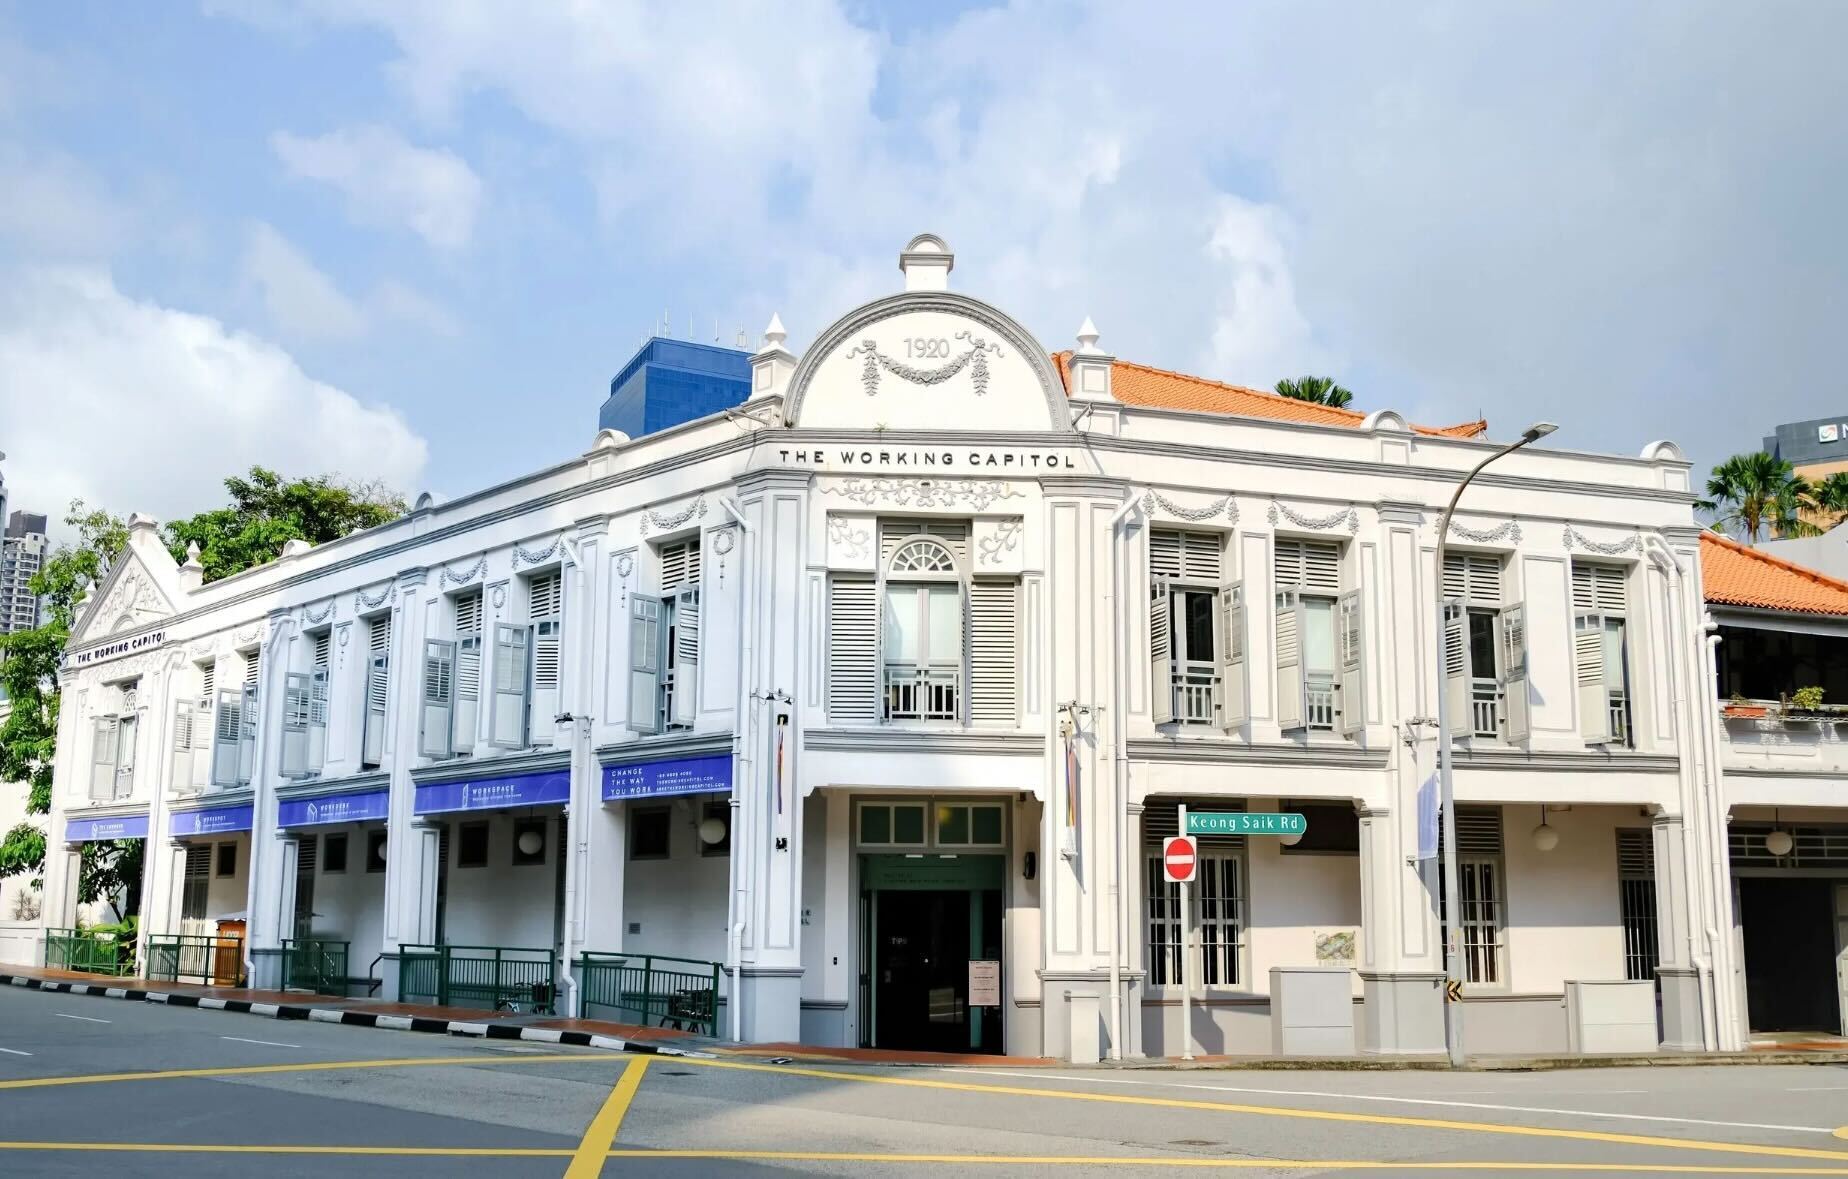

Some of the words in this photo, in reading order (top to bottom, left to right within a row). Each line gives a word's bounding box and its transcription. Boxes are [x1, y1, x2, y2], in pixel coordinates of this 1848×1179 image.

[903, 338, 950, 359] 1920
[780, 450, 824, 463] THE
[841, 451, 953, 465] WORKING
[969, 453, 1075, 468] CAPITOL
[78, 652, 92, 664] THE
[95, 642, 129, 659] WORKING
[611, 768, 643, 777] CHANGE
[472, 785, 516, 795] WORKSPACE
[610, 788, 626, 796] YOU
[630, 786, 652, 795] WORK
[1190, 816, 1236, 831] Keong
[1242, 816, 1274, 829] Saik
[1281, 817, 1298, 829] Rd
